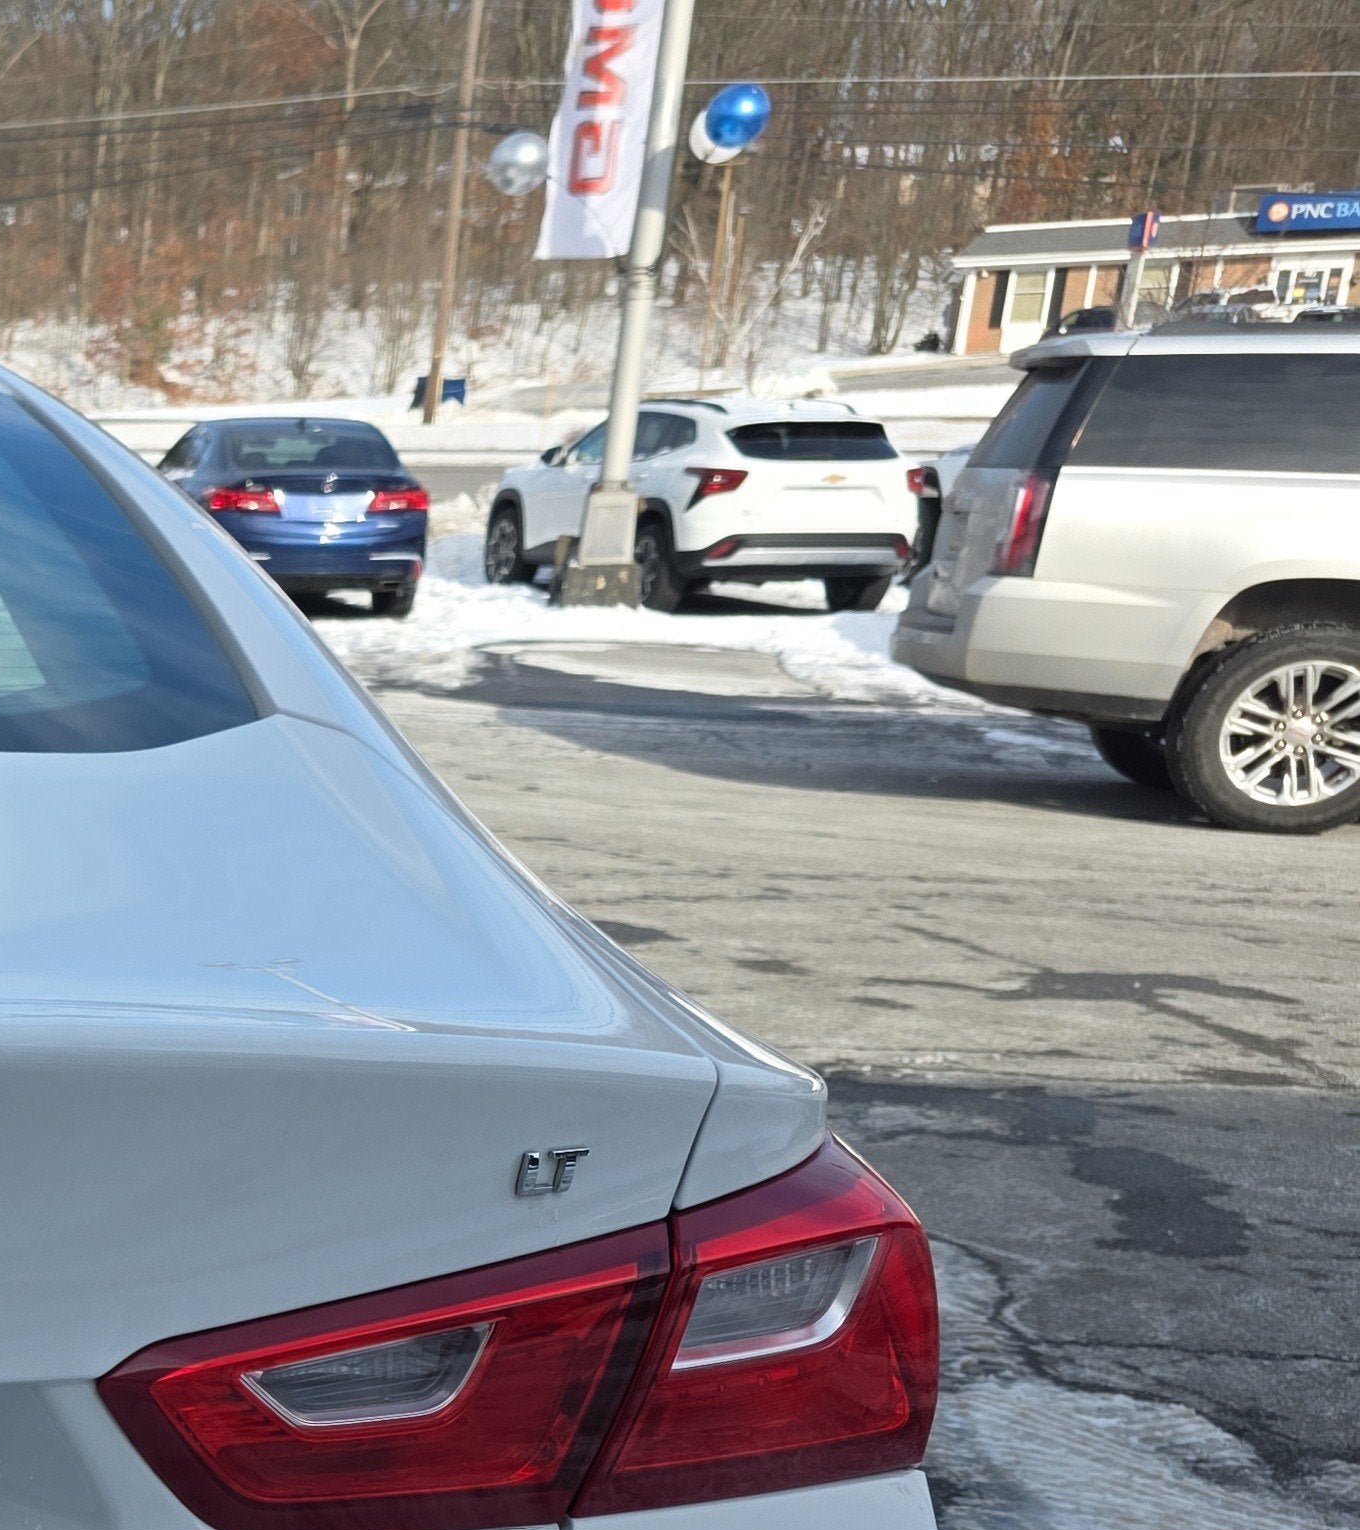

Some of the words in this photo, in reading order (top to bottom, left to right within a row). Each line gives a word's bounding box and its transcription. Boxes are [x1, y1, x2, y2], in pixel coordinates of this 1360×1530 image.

[567, 0, 640, 197] GM
[1291, 202, 1335, 220] PNC
[514, 1147, 590, 1197] LT
